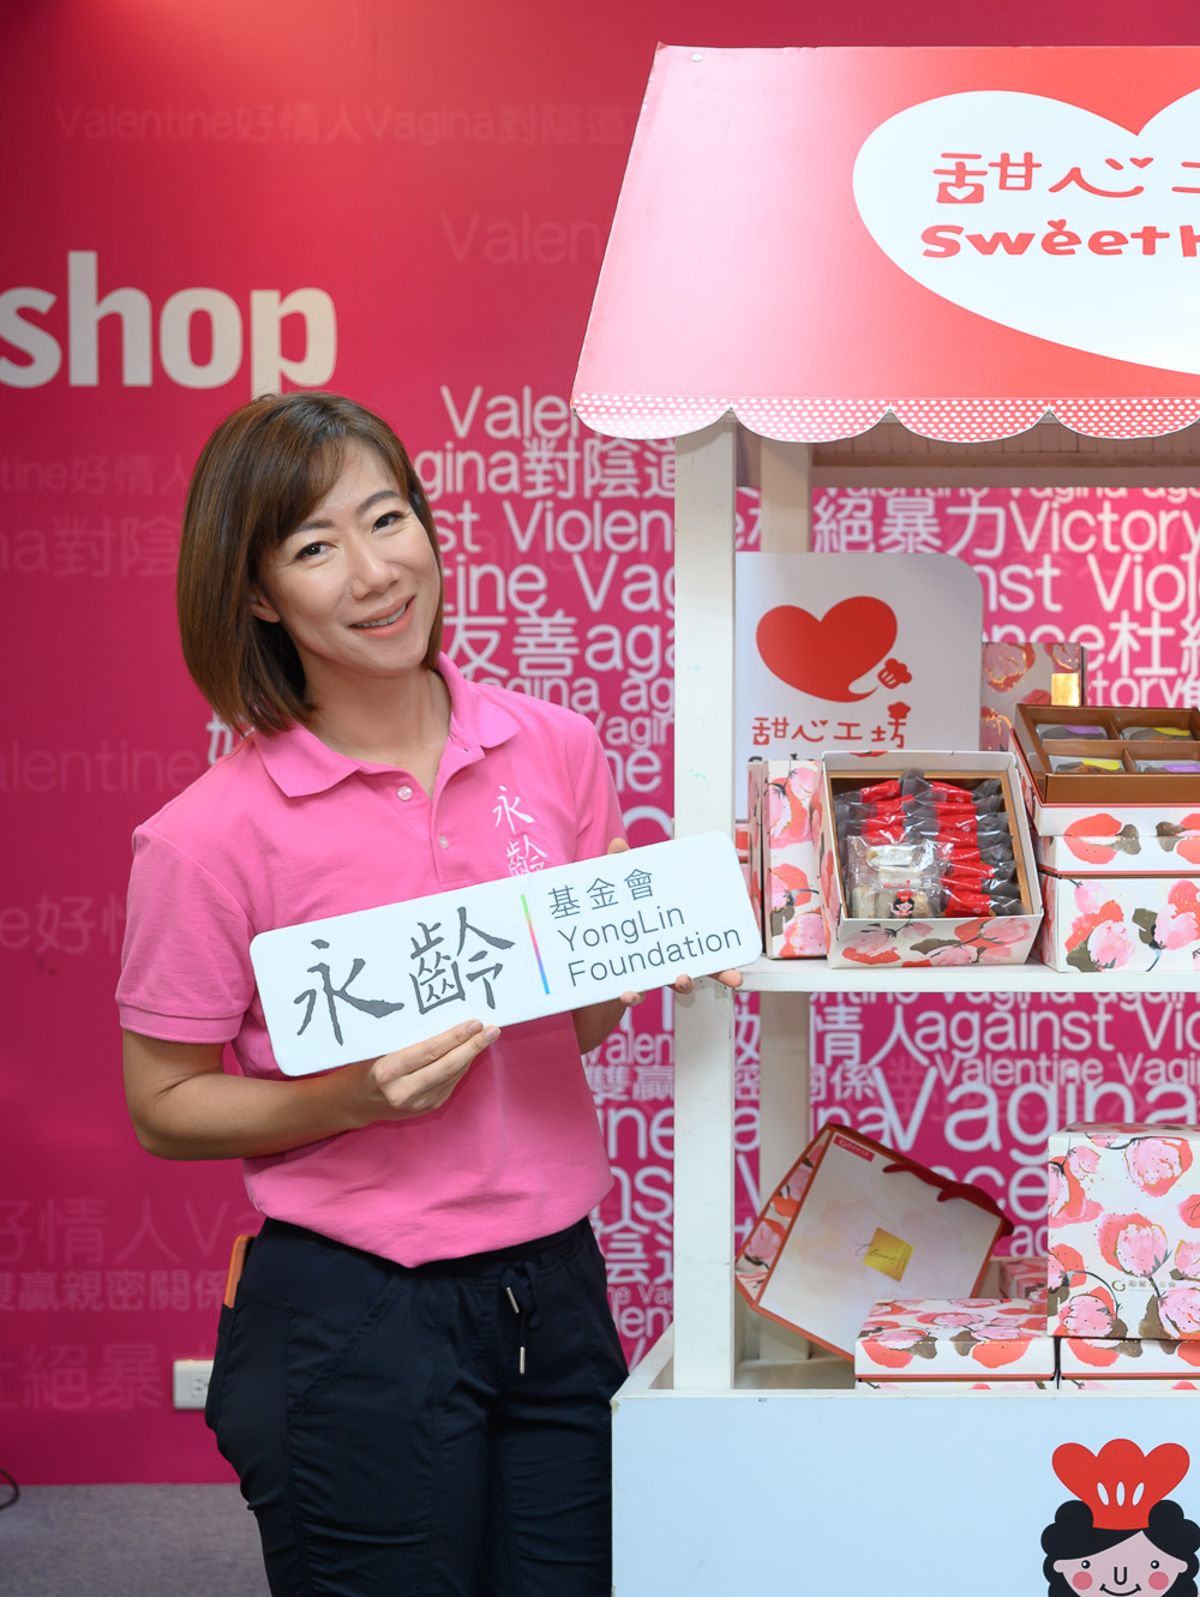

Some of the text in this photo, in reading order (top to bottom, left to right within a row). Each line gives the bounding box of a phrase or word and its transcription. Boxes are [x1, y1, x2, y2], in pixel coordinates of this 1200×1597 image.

[443, 553, 548, 613] ine
[752, 701, 907, 749] 甜心工坊
[548, 867, 654, 921] 基金會
[557, 904, 686, 953] YongLin
[567, 925, 743, 988] Foundation
[293, 906, 516, 1047] 永齡
